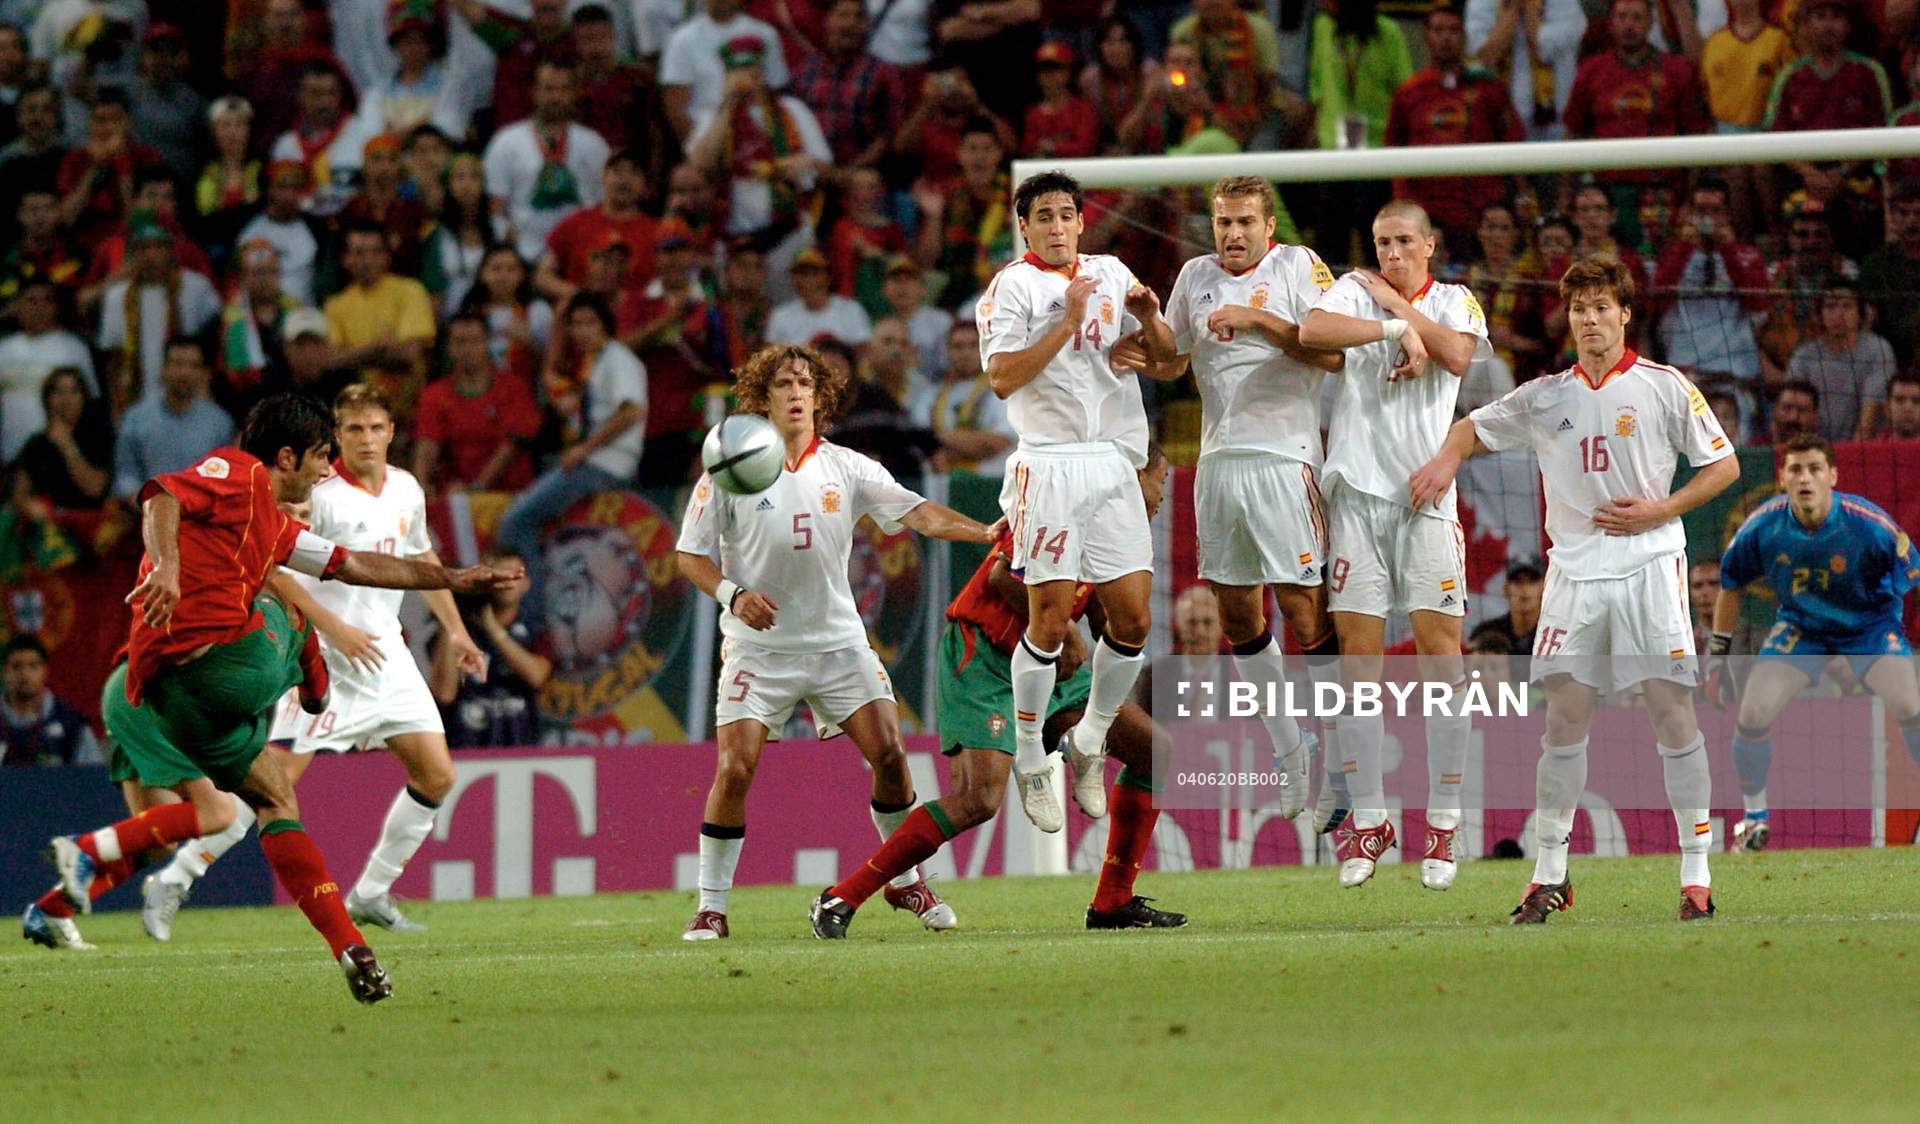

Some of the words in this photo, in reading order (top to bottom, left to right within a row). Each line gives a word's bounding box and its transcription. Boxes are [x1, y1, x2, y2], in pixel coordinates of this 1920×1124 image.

[1073, 318, 1101, 350] 14
[1579, 435, 1609, 473] 16
[792, 513, 812, 550] 5
[1030, 526, 1068, 564] 14
[1331, 557, 1350, 594] 9
[1536, 626, 1567, 662] 16
[728, 669, 756, 702] 5
[306, 711, 337, 736] 19
[431, 756, 597, 900] T
